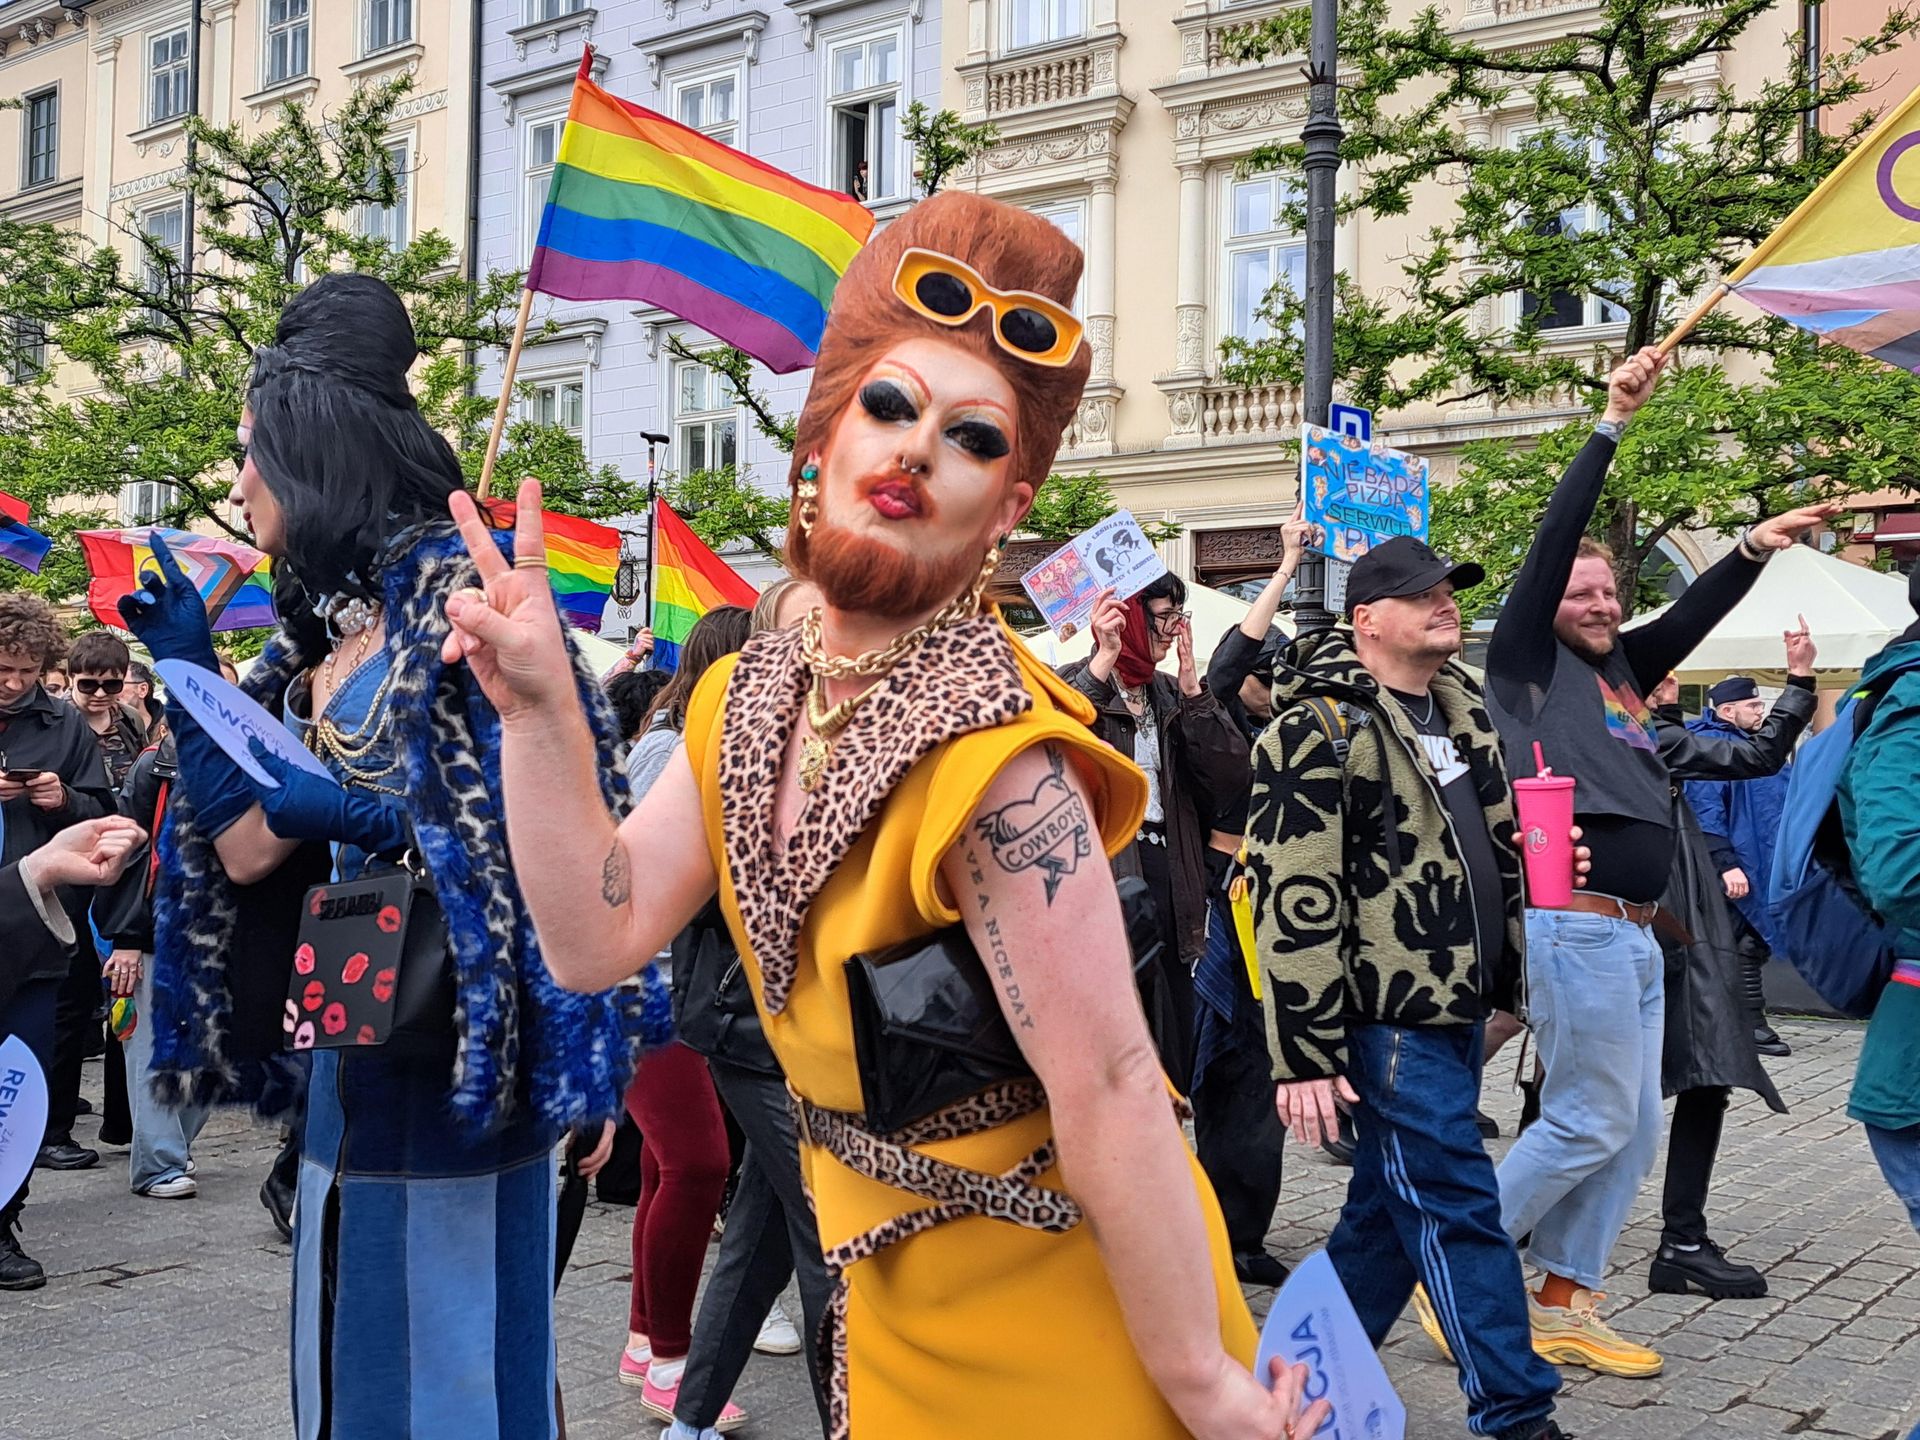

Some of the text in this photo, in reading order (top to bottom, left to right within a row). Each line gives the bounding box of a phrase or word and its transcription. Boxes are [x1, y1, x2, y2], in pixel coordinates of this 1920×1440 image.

[1323, 459, 1362, 482] NIE
[1005, 800, 1083, 868] COWBOYS
[977, 893, 990, 911] A
[985, 917, 1012, 980] NICE
[1006, 983, 1034, 1029] DAY
